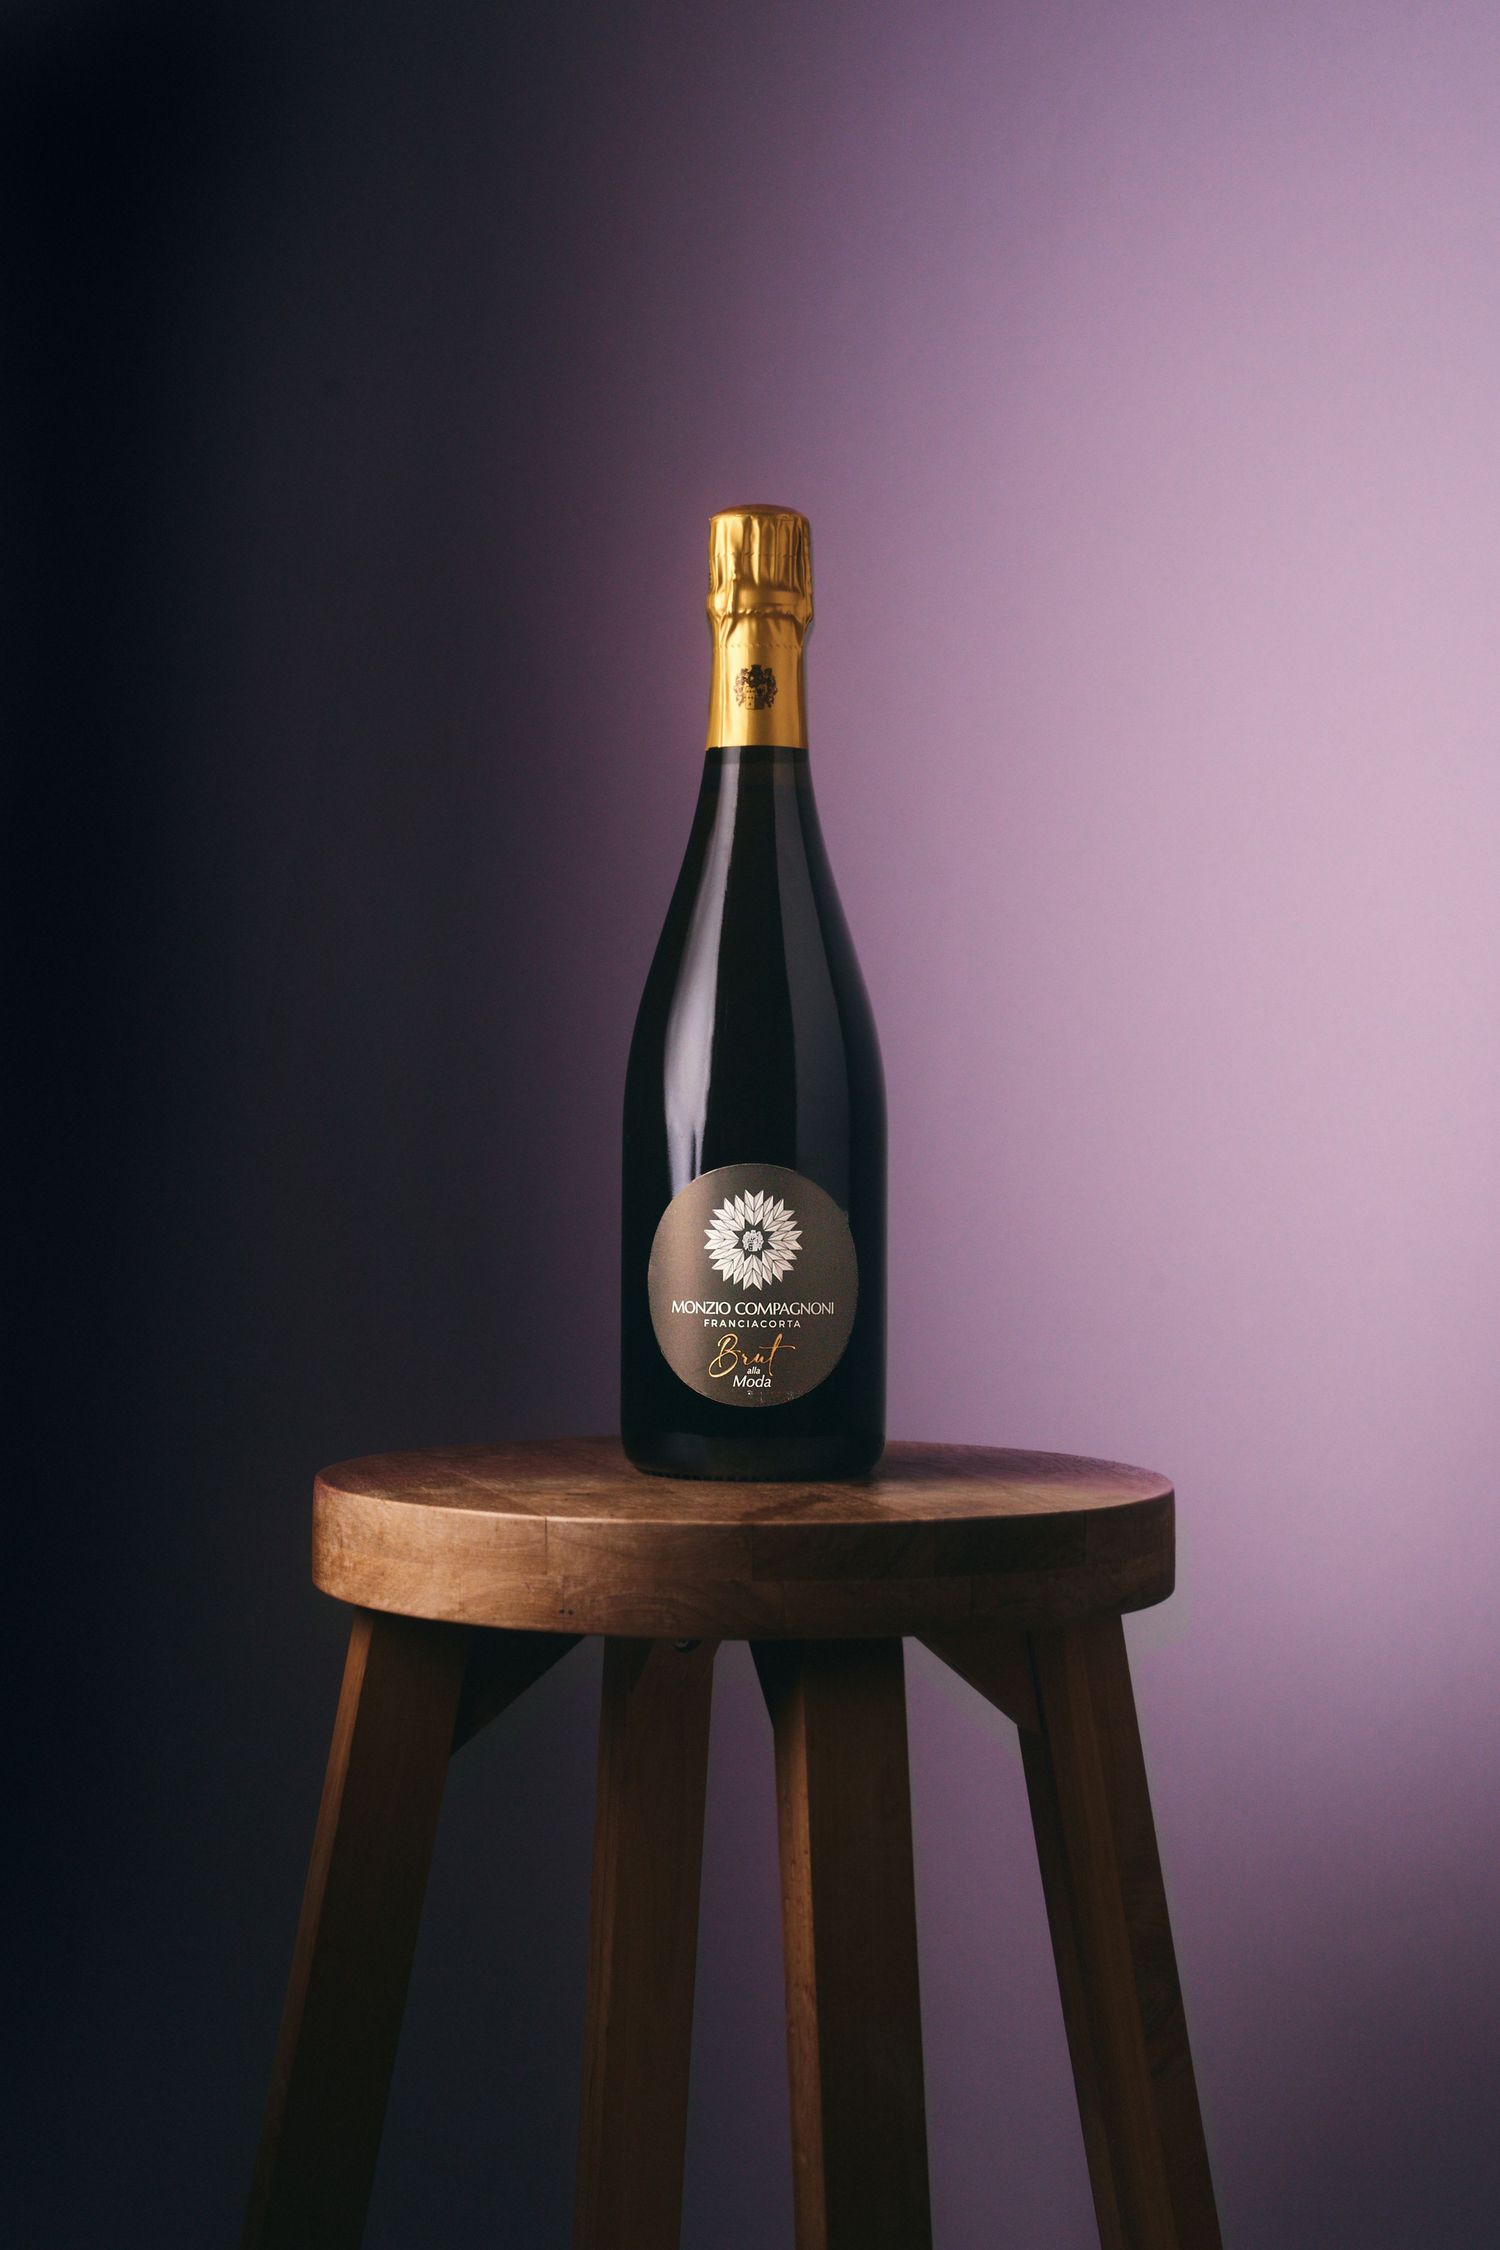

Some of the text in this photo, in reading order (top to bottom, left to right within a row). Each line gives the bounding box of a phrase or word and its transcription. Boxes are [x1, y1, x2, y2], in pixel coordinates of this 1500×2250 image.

[671, 1300, 834, 1315] MONZIO COMPAGNONI
[703, 1318, 801, 1328] FRANCIACORTA
[708, 1333, 796, 1378] Brut
[746, 1366, 761, 1375] alla
[732, 1375, 772, 1388] Moda
